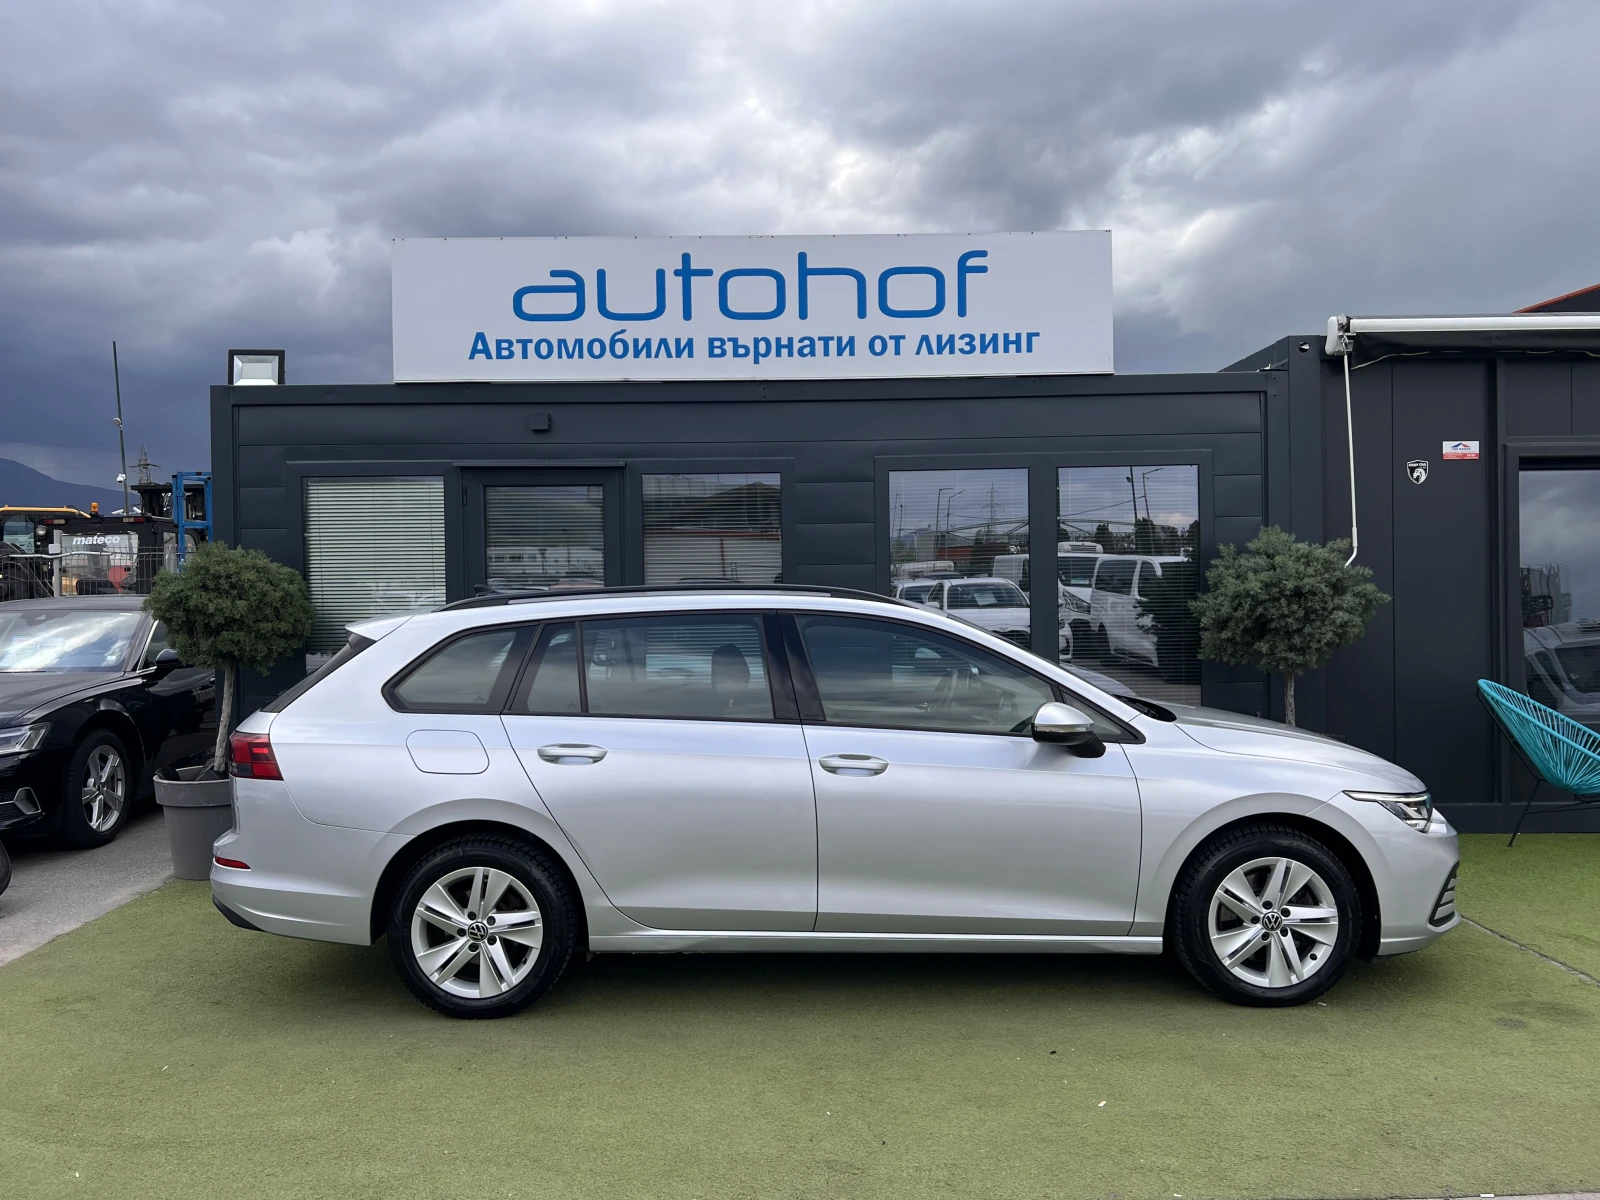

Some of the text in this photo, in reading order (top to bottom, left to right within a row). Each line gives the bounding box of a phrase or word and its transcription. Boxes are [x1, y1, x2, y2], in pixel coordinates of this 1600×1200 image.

[512, 249, 989, 322] autohof
[469, 330, 1041, 365] Автомобили върнати от лизинг
[72, 534, 121, 545] mateco
